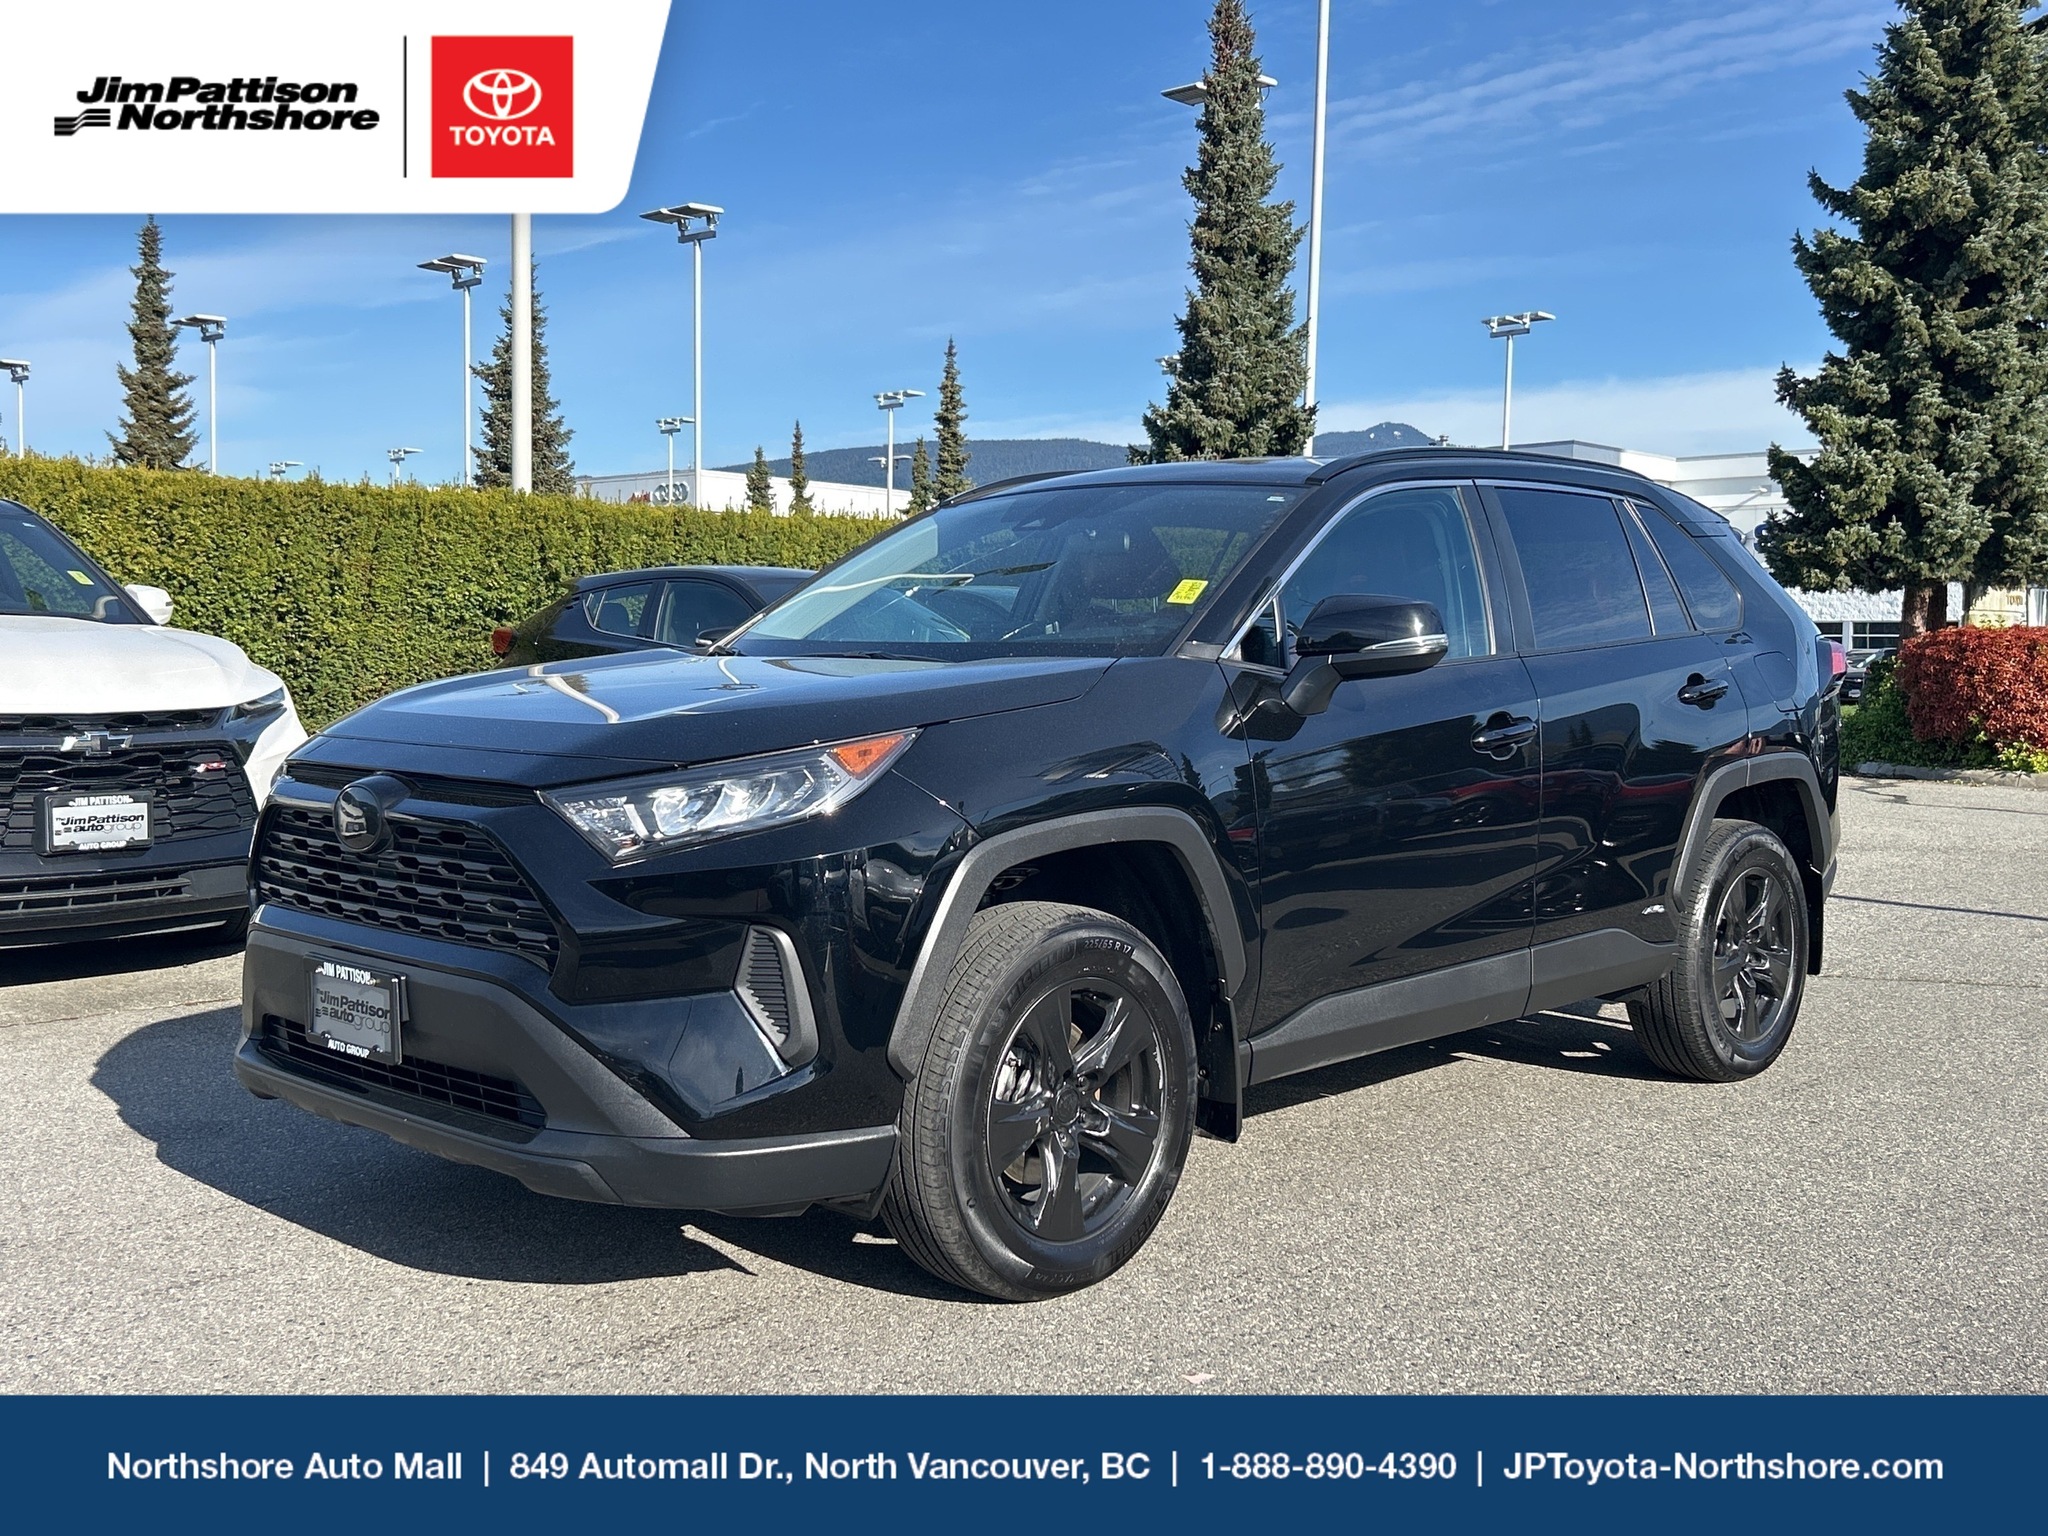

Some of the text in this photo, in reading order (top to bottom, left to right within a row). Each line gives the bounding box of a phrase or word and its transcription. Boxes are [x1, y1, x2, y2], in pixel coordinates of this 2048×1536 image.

[89, 795, 130, 806] PATTISON
[78, 840, 127, 851] AUTO GROUP
[1114, 941, 1121, 951] R
[1122, 944, 1132, 954] 17
[323, 962, 371, 985] JIM PATTISON
[327, 1039, 370, 1058] AUTO GROUP
